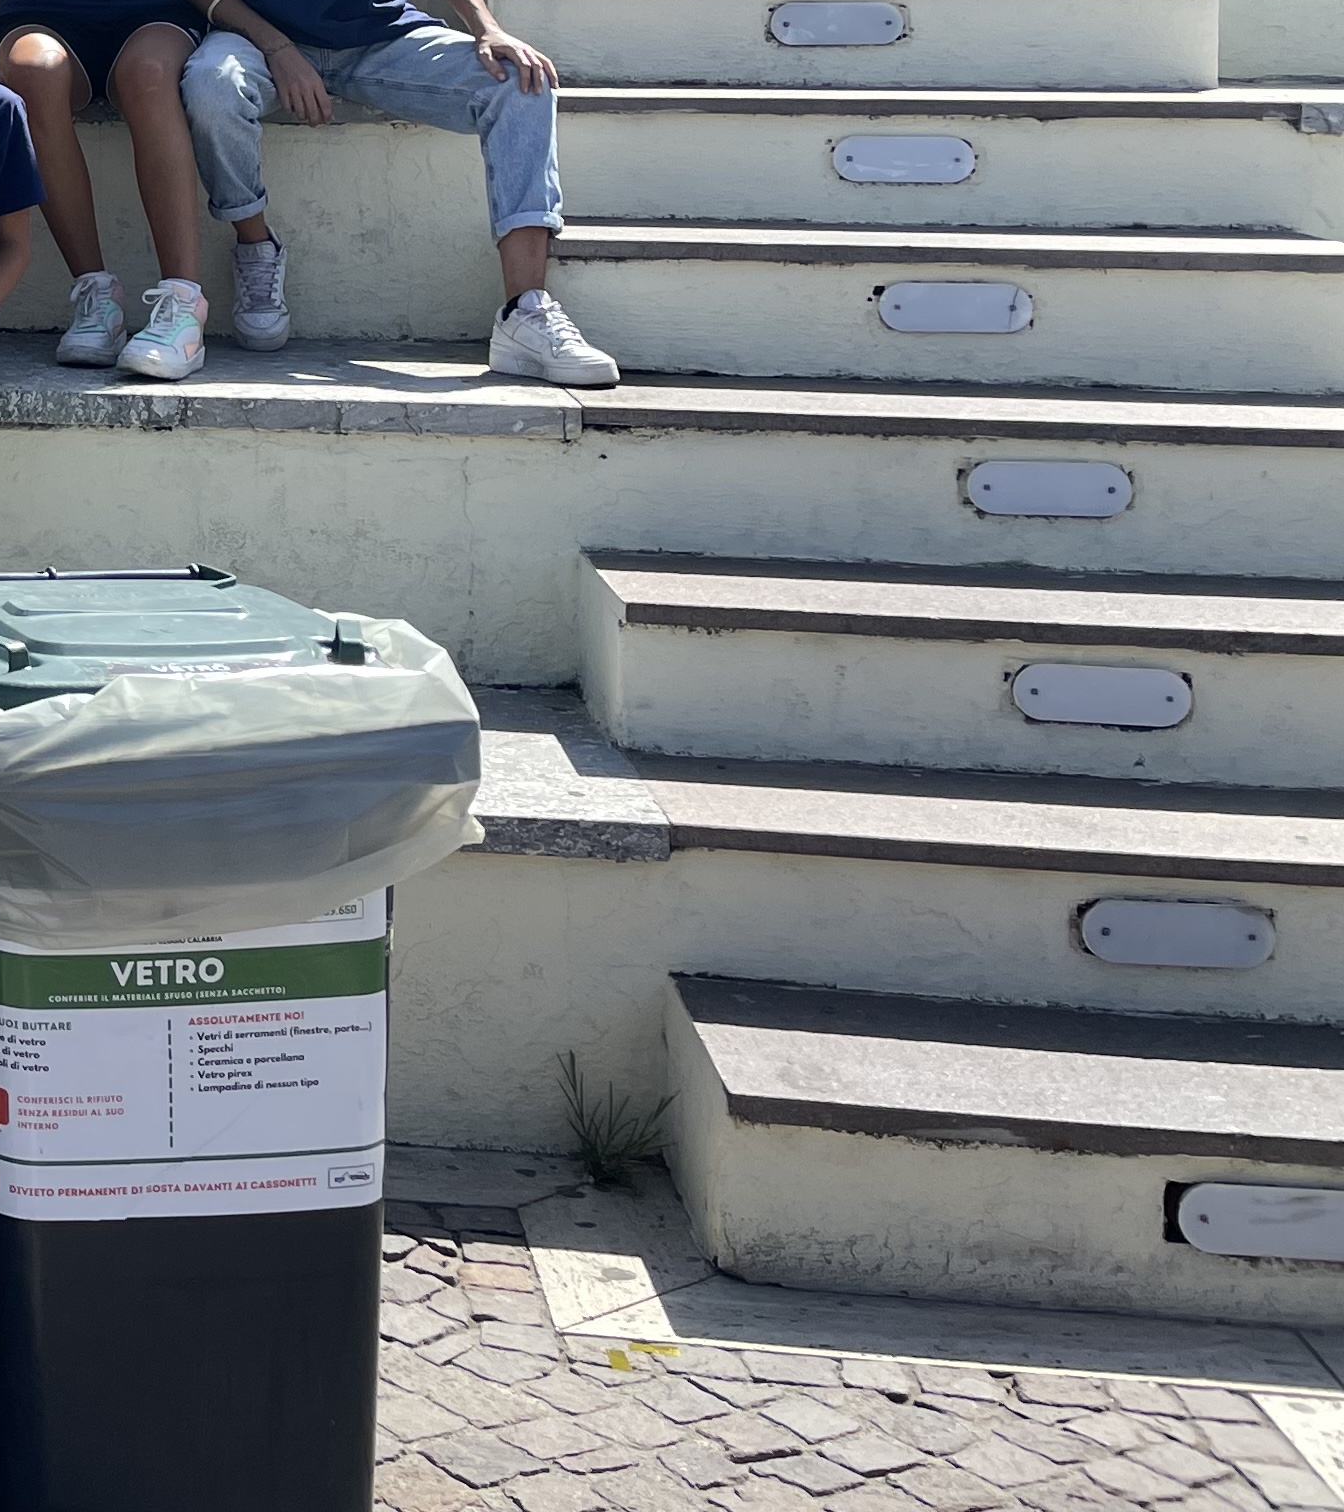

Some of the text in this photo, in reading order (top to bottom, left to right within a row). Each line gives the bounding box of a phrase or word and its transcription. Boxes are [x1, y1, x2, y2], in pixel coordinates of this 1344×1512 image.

[109, 957, 226, 988] VETRO
[48, 985, 286, 1004] CONFERIRE IL MATERIALE SFUSO (SENZA SACCHETTO)
[188, 1011, 305, 1026] ASSOLUTAMENTE NO!
[21, 1021, 72, 1031] BUTTARE
[196, 1026, 288, 1042] Vetri serramenti
[197, 1043, 234, 1055] Specchi
[197, 1053, 305, 1067] Ceramica porcellana
[197, 1070, 253, 1081] Vetro pirex
[197, 1078, 320, 1094] Lampadine nessun tipo
[16, 1095, 124, 1104] CONFERISCI RIFIUTO
[17, 1107, 125, 1117] SENZA RESIDUI SUO
[17, 1121, 60, 1130] INTERNO
[9, 1177, 318, 1197] DIVIETO PERMANENTE DI SOSTA DAVANTI AI CASSONETTI
